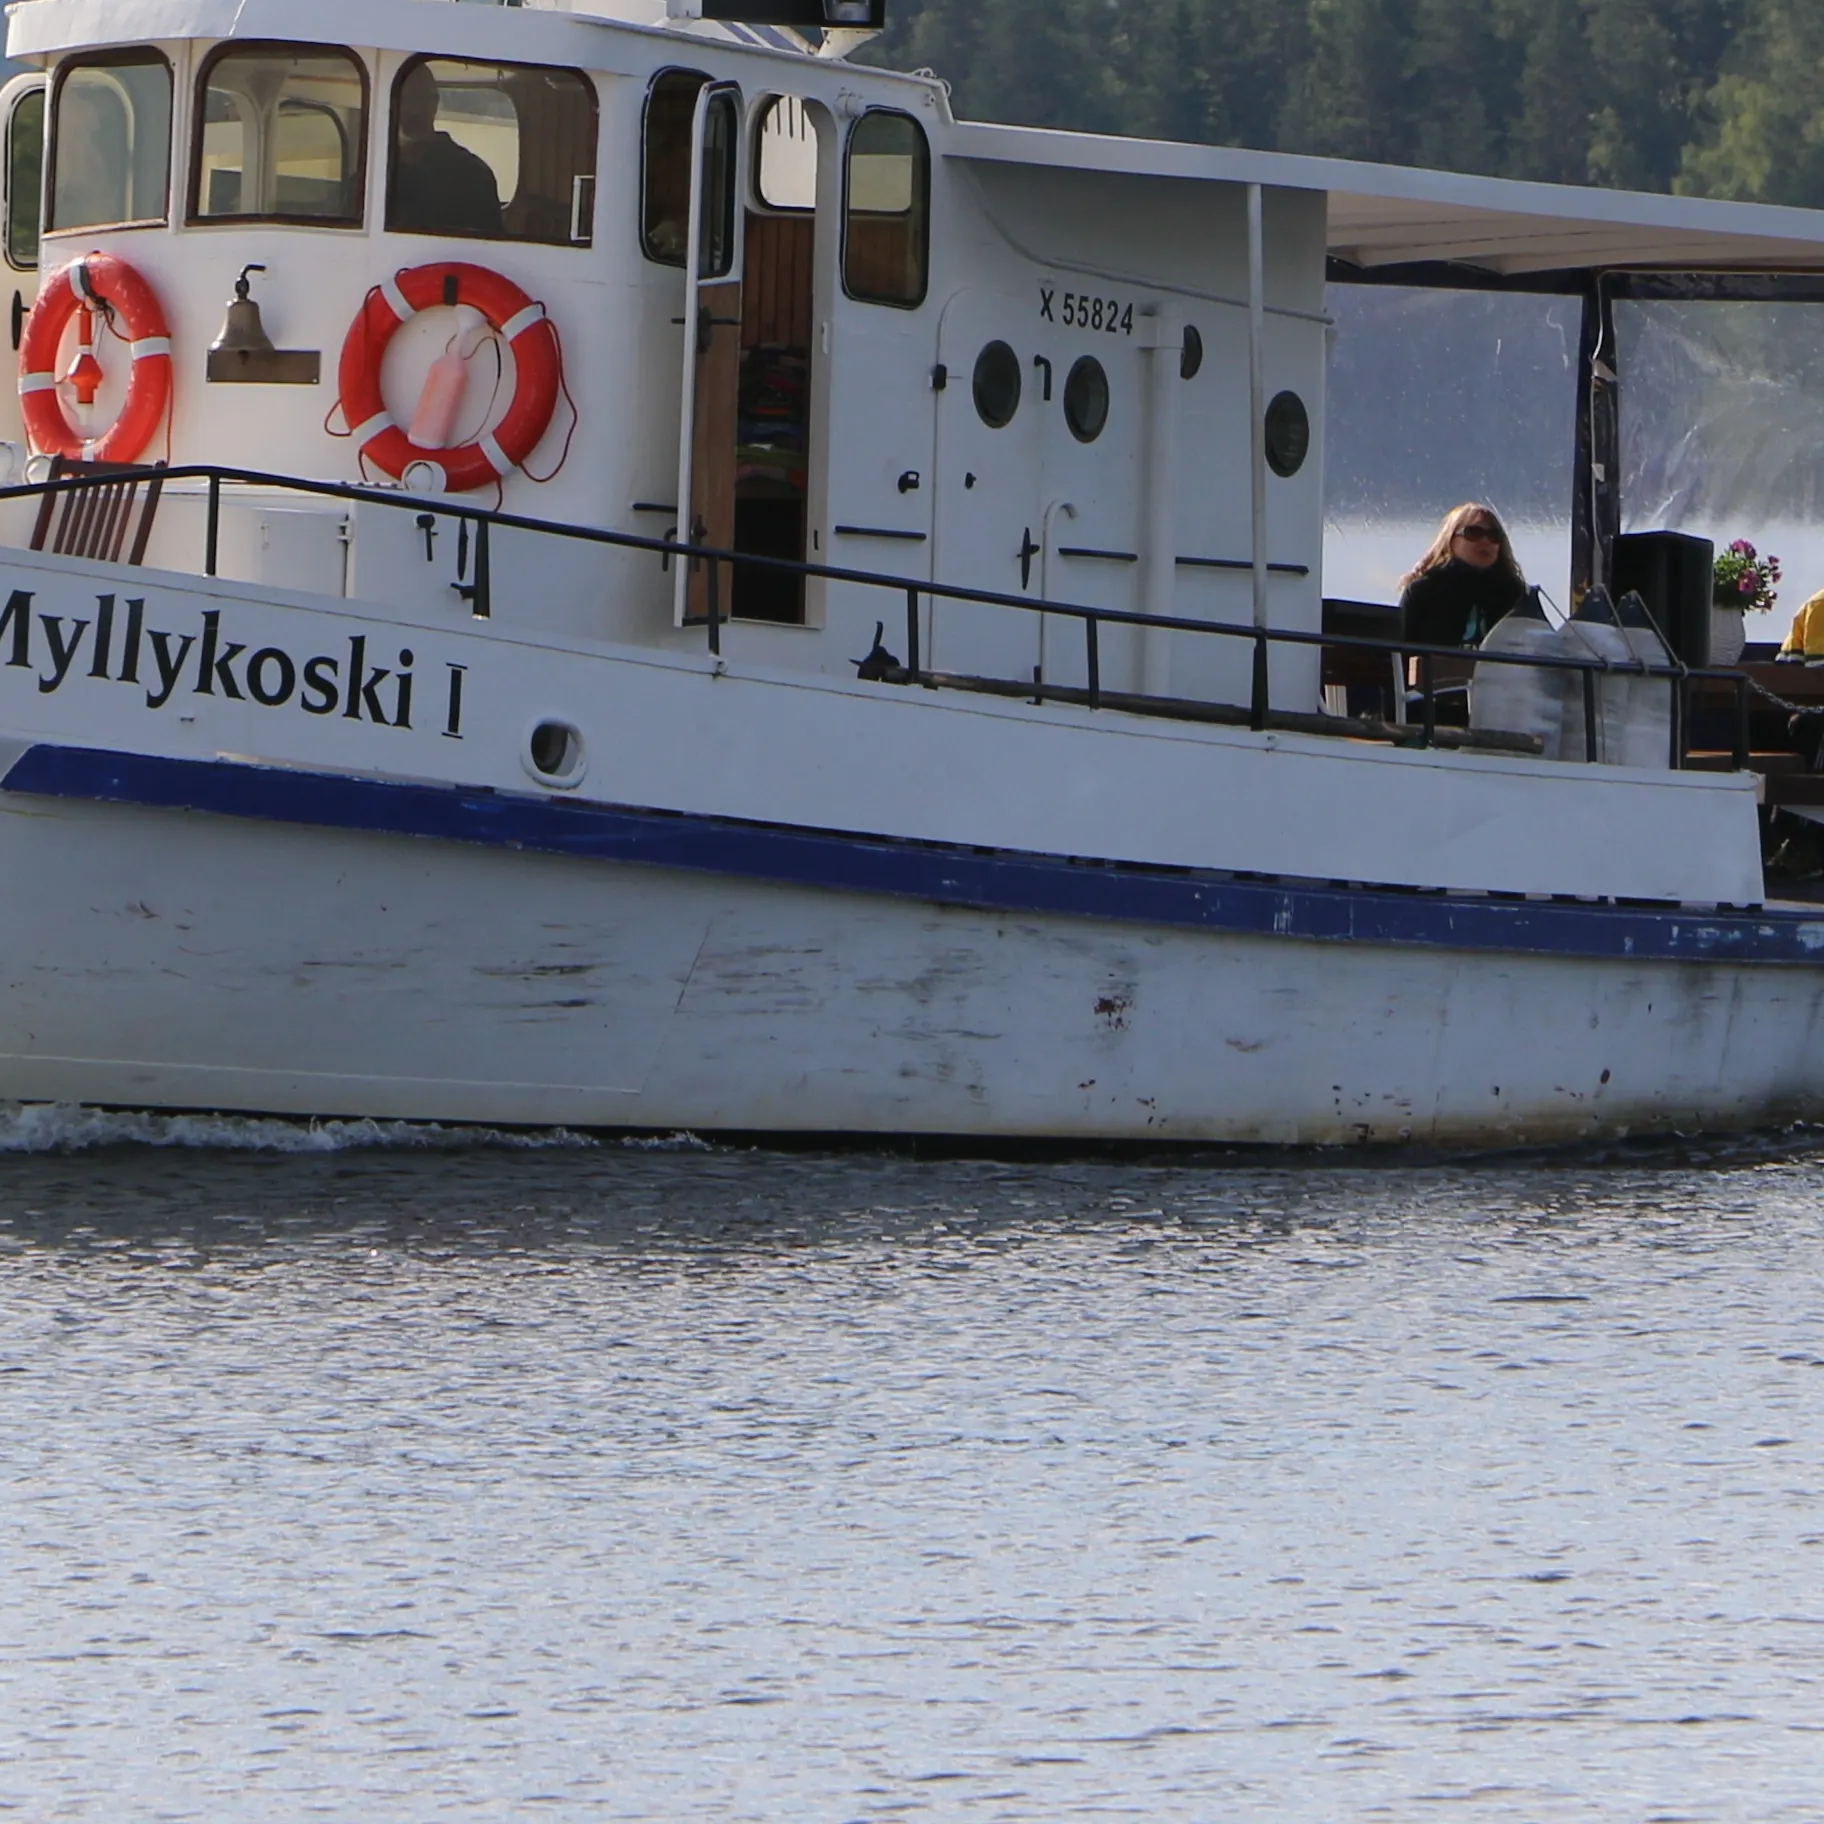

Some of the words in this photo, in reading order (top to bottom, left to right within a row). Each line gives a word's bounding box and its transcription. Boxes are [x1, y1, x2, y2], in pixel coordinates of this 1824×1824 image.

[1039, 287, 1055, 323] X
[1062, 292, 1134, 336] 55824
[440, 662, 469, 740] I
